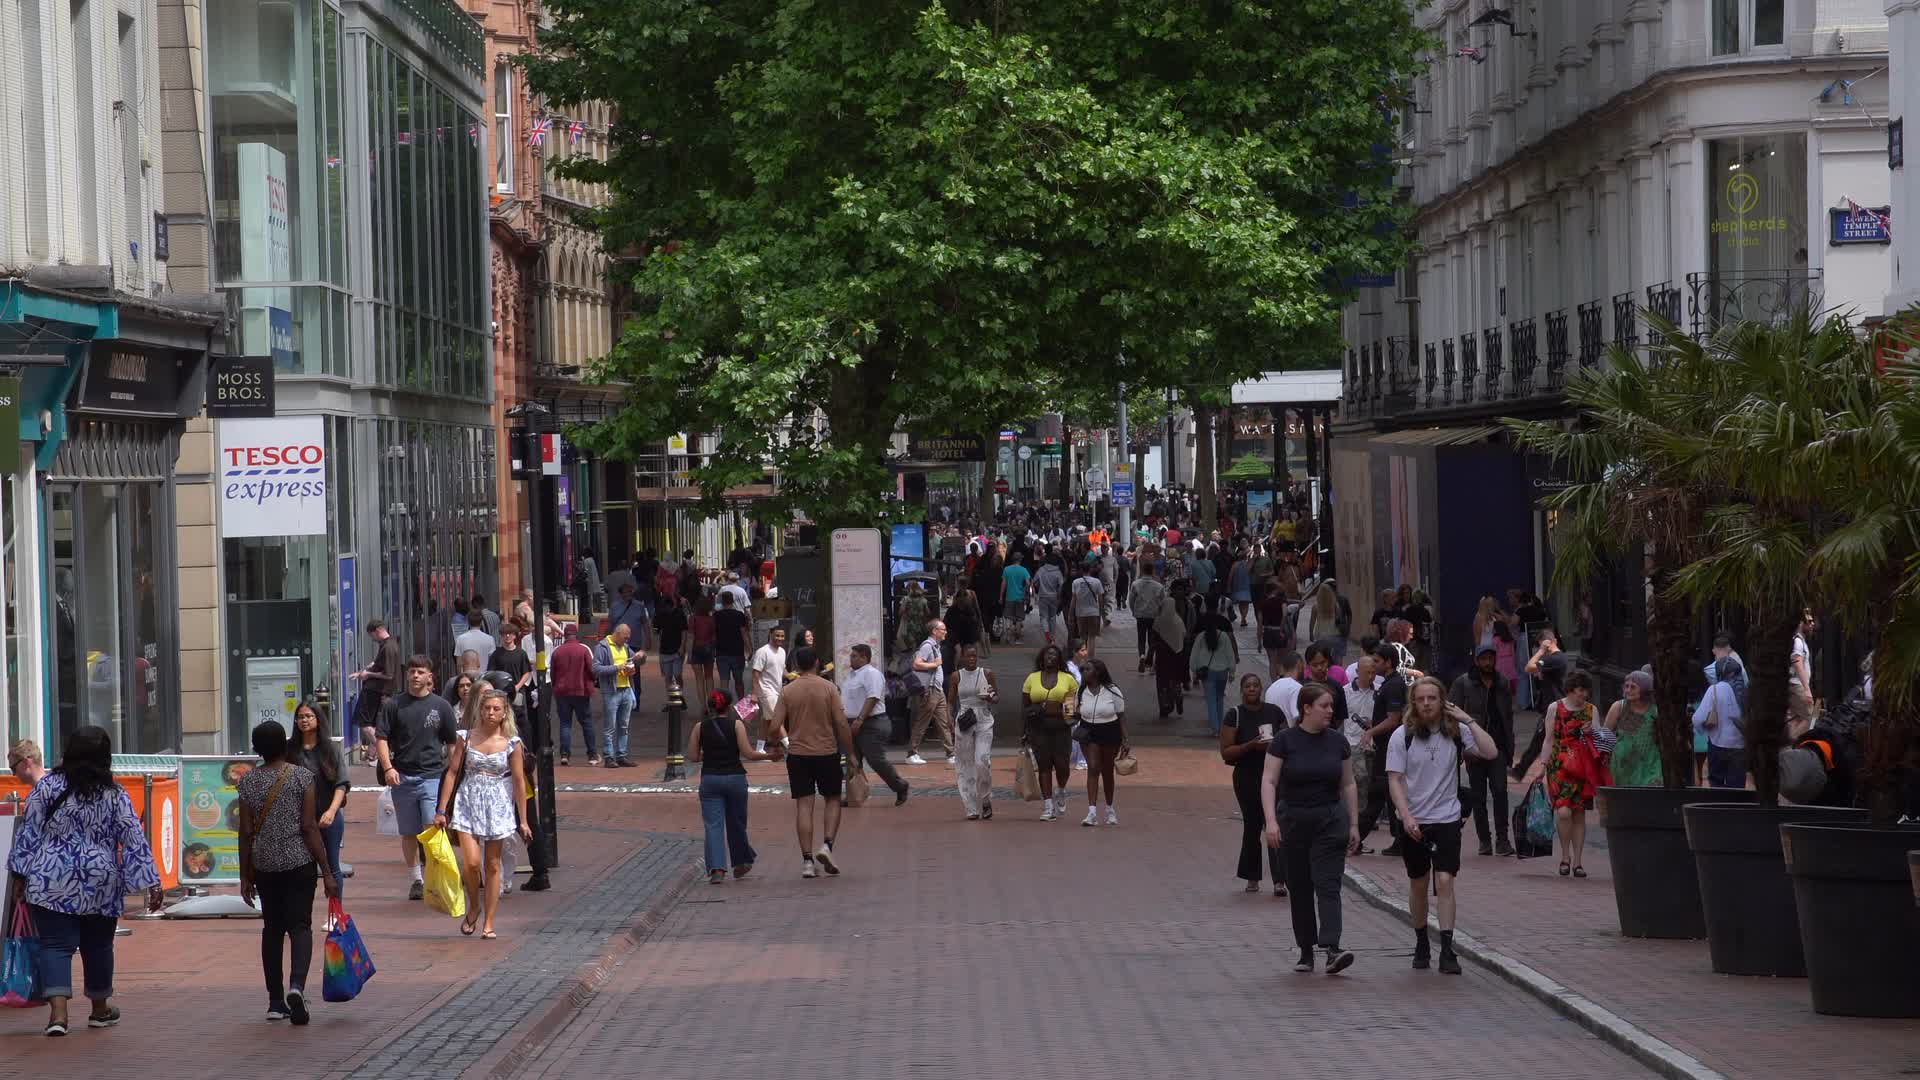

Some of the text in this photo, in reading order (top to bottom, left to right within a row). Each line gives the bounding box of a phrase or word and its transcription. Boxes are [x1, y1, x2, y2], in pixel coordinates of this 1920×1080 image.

[218, 372, 262, 384] MOSS
[218, 387, 266, 400] BROS.
[917, 440, 978, 449] BRITANNIA
[224, 445, 323, 466] TESCO
[226, 480, 324, 505] express
[260, 709, 276, 717] 100
[198, 792, 210, 808] 8
